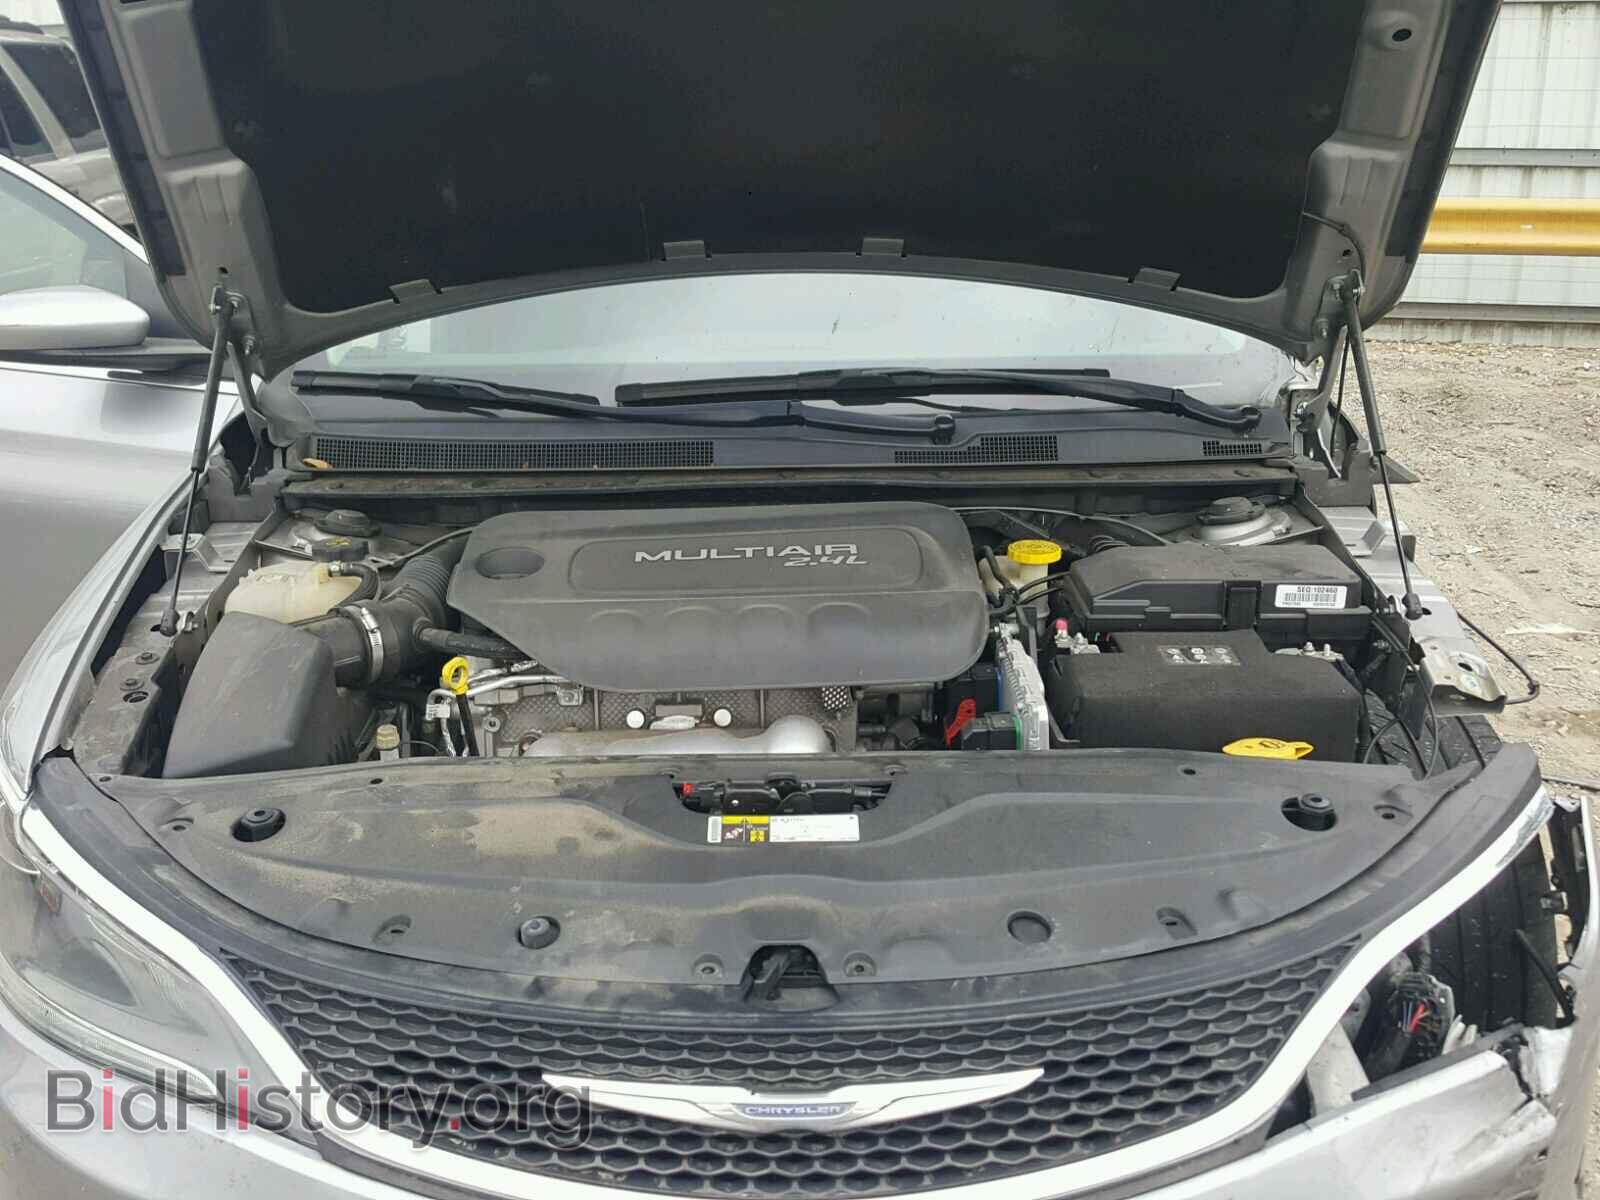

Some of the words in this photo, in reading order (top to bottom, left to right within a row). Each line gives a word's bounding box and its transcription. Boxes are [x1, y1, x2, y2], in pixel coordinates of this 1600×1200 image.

[635, 544, 857, 562] MULTIAIR
[783, 555, 868, 567] 2.4L
[745, 1105, 841, 1114] CHRYSLER
